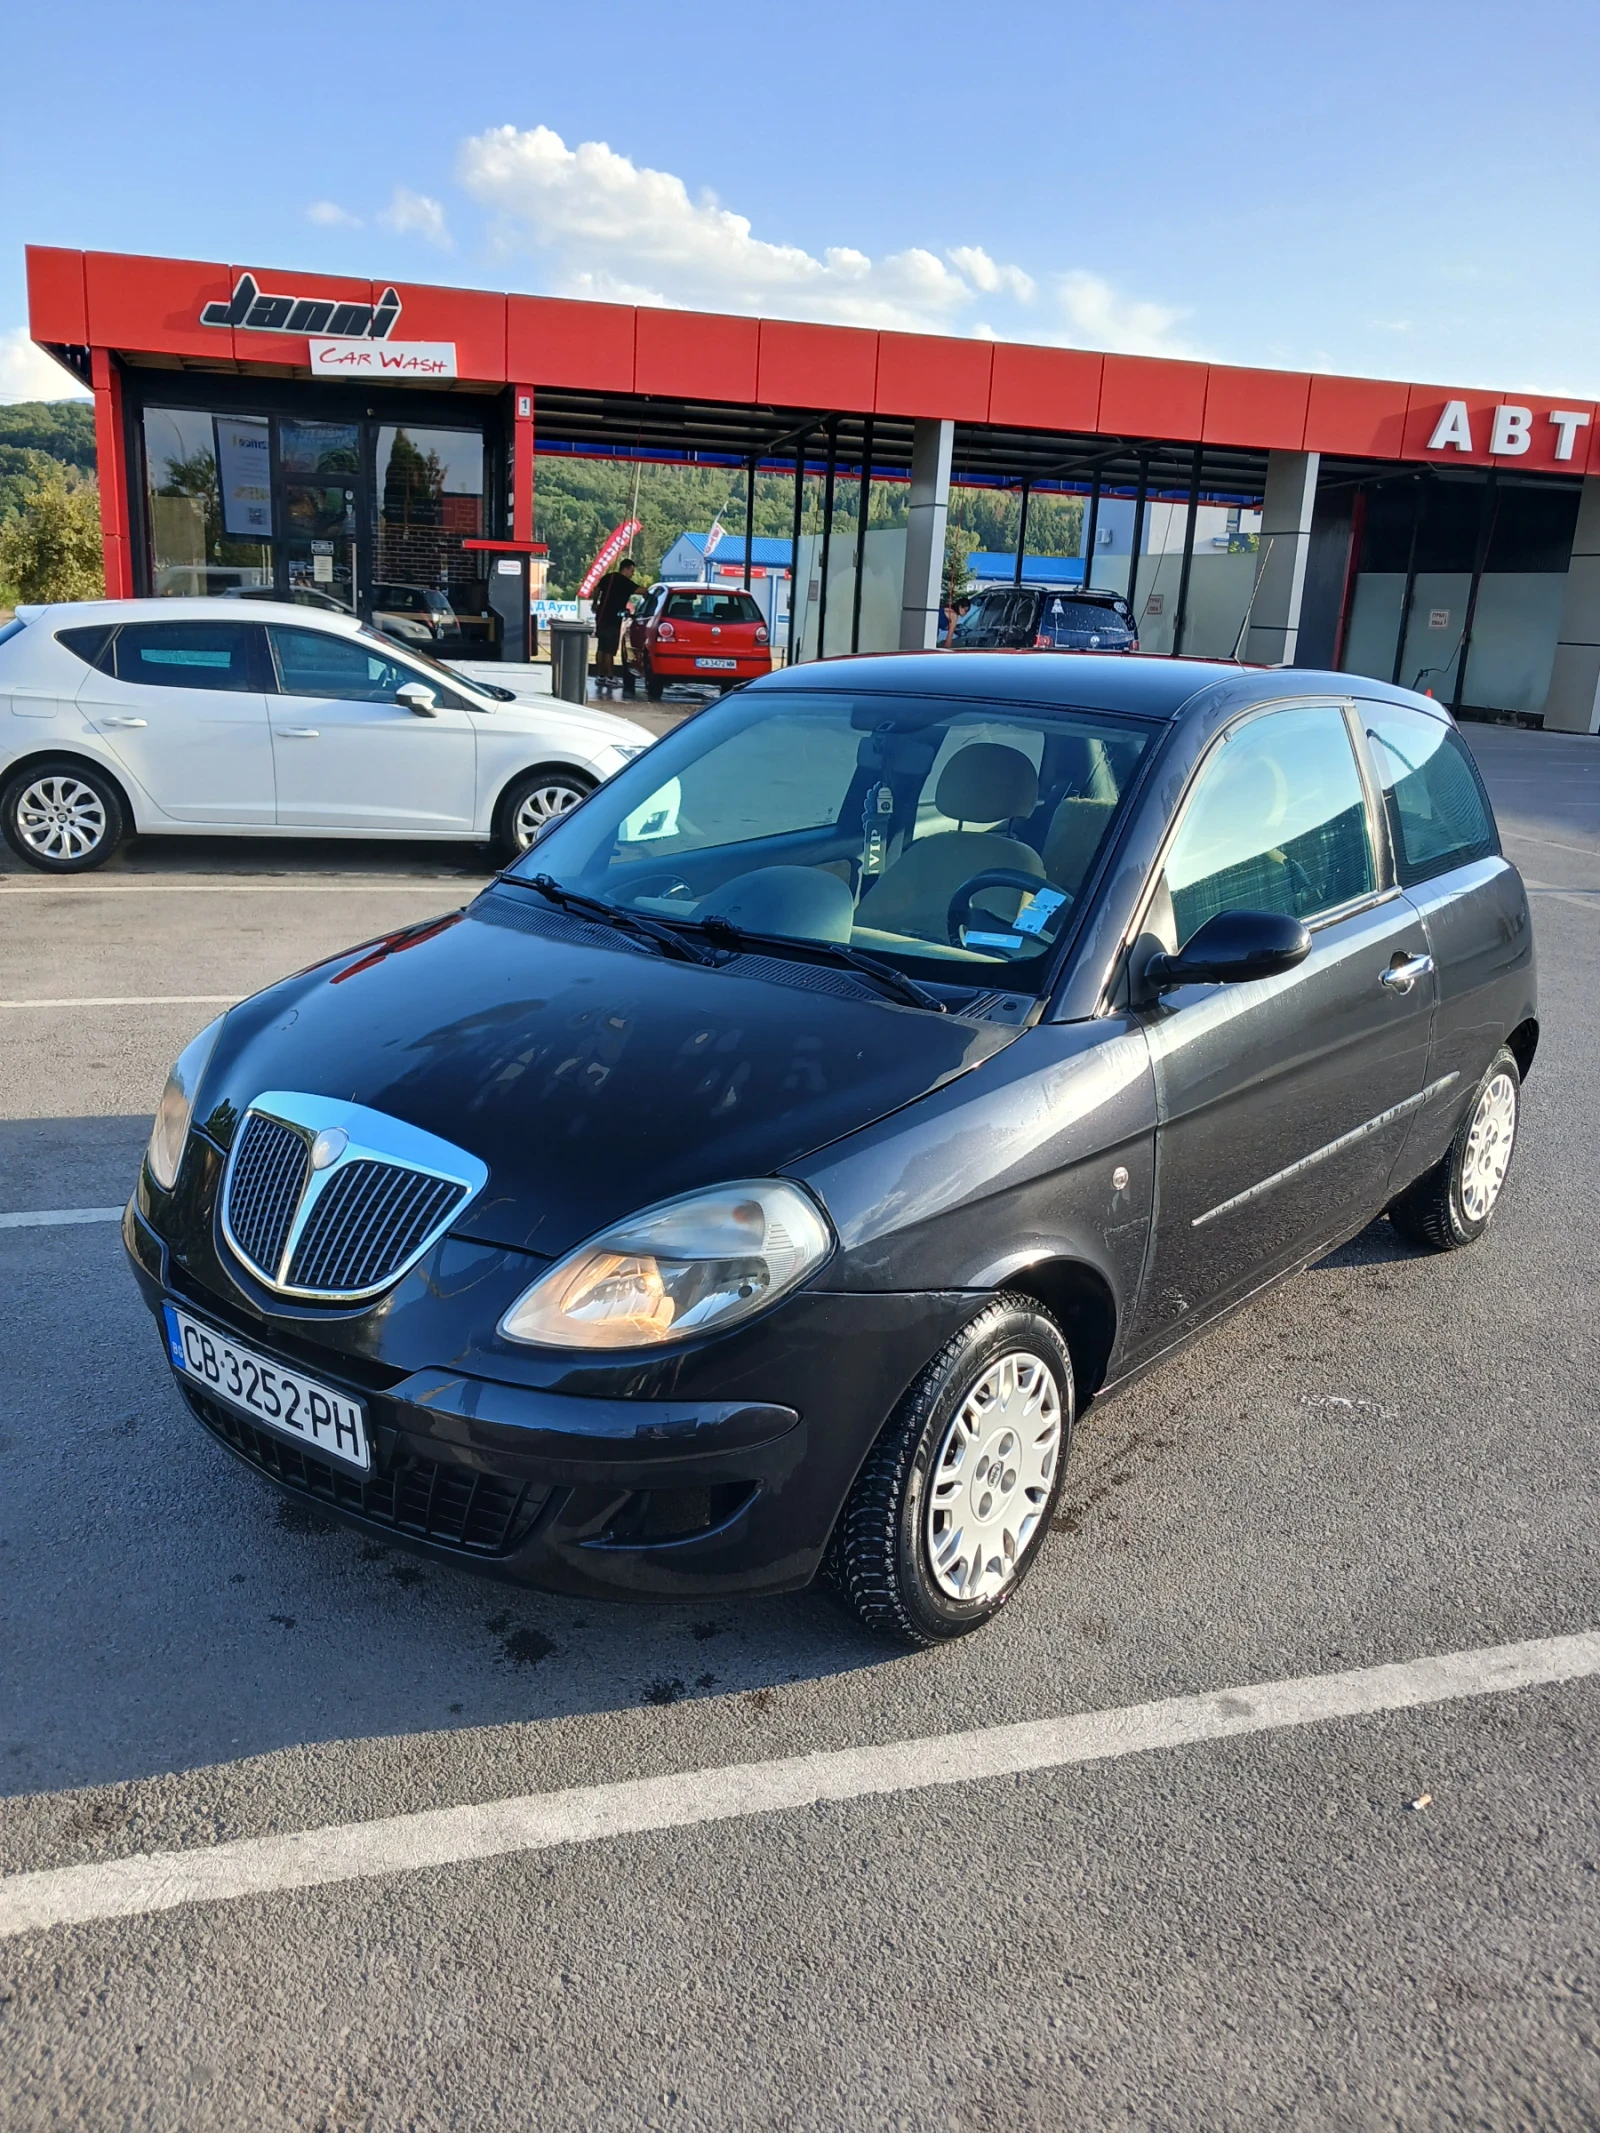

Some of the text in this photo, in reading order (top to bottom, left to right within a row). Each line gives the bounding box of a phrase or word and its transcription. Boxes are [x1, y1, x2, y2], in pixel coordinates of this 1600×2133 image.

[521, 399, 528, 410] 1
[548, 601, 577, 613] Ауто
[172, 1342, 184, 1358] BG
